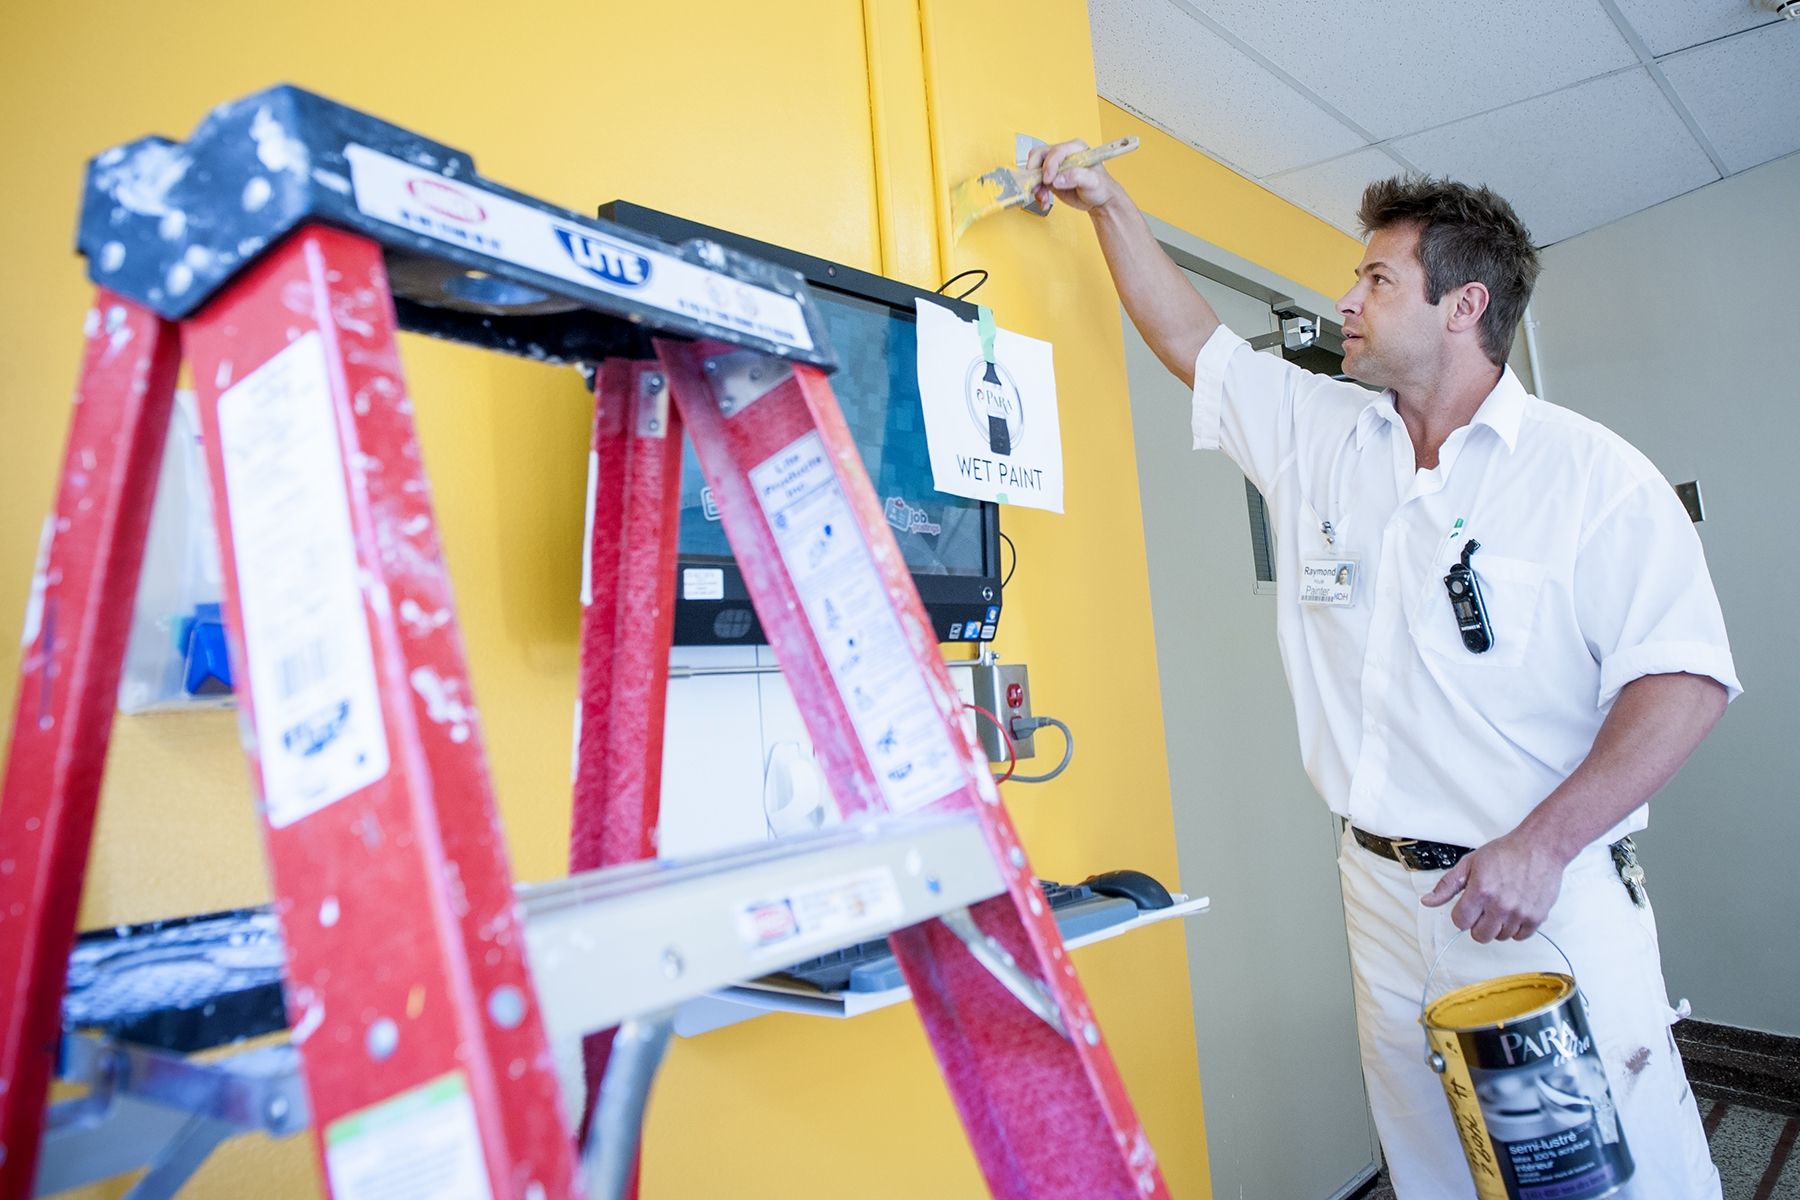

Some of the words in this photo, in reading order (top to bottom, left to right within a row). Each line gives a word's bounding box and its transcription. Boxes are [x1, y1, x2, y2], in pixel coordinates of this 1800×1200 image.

[568, 233, 642, 283] LITE
[986, 389, 1013, 415] PARA
[956, 454, 992, 482] WET
[999, 462, 1043, 490] PAINT
[910, 509, 928, 528] job
[1304, 566, 1337, 578] Raymond
[1306, 585, 1330, 596] Painter
[1500, 1020, 1579, 1065] PARA
[1509, 1131, 1577, 1155] semi-lustré
